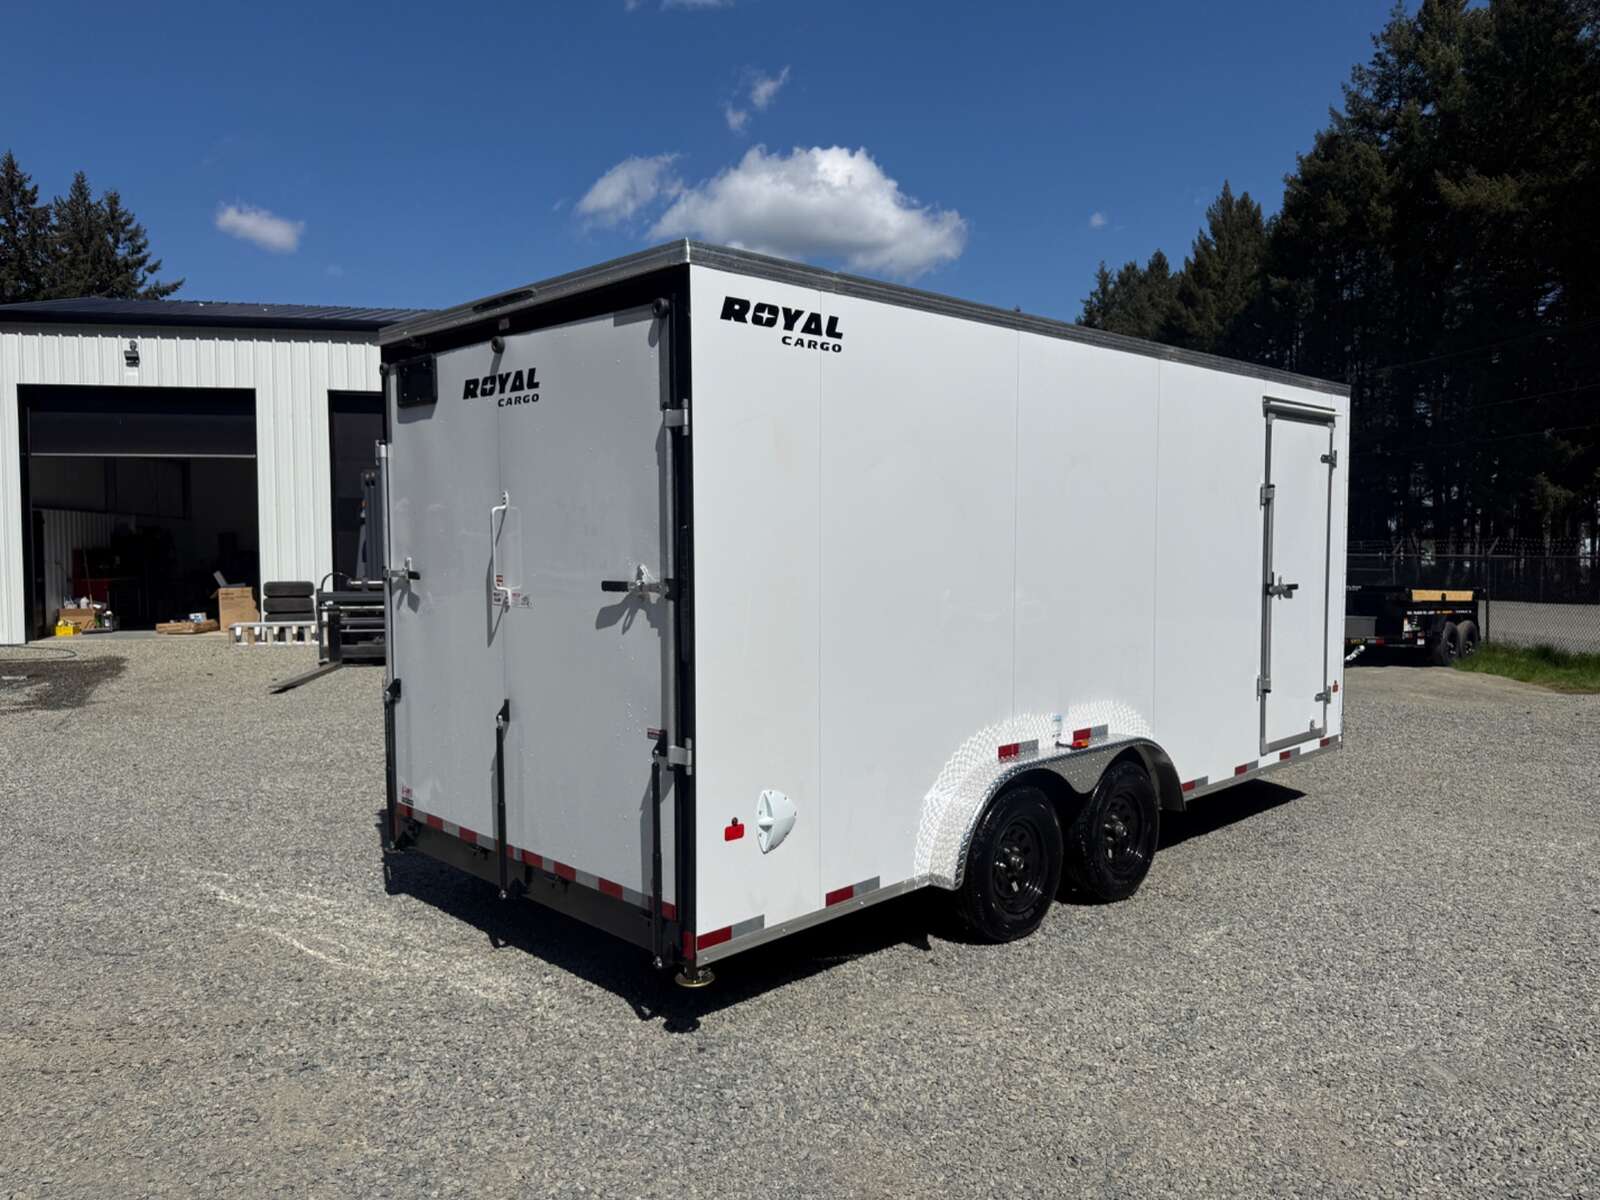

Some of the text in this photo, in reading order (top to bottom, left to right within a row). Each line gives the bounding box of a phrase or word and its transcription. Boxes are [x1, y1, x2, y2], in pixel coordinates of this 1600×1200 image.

[720, 296, 843, 340] ROYAL
[781, 335, 842, 353] CARGO
[463, 367, 540, 400] ROYAL
[497, 393, 540, 407] CARGO
